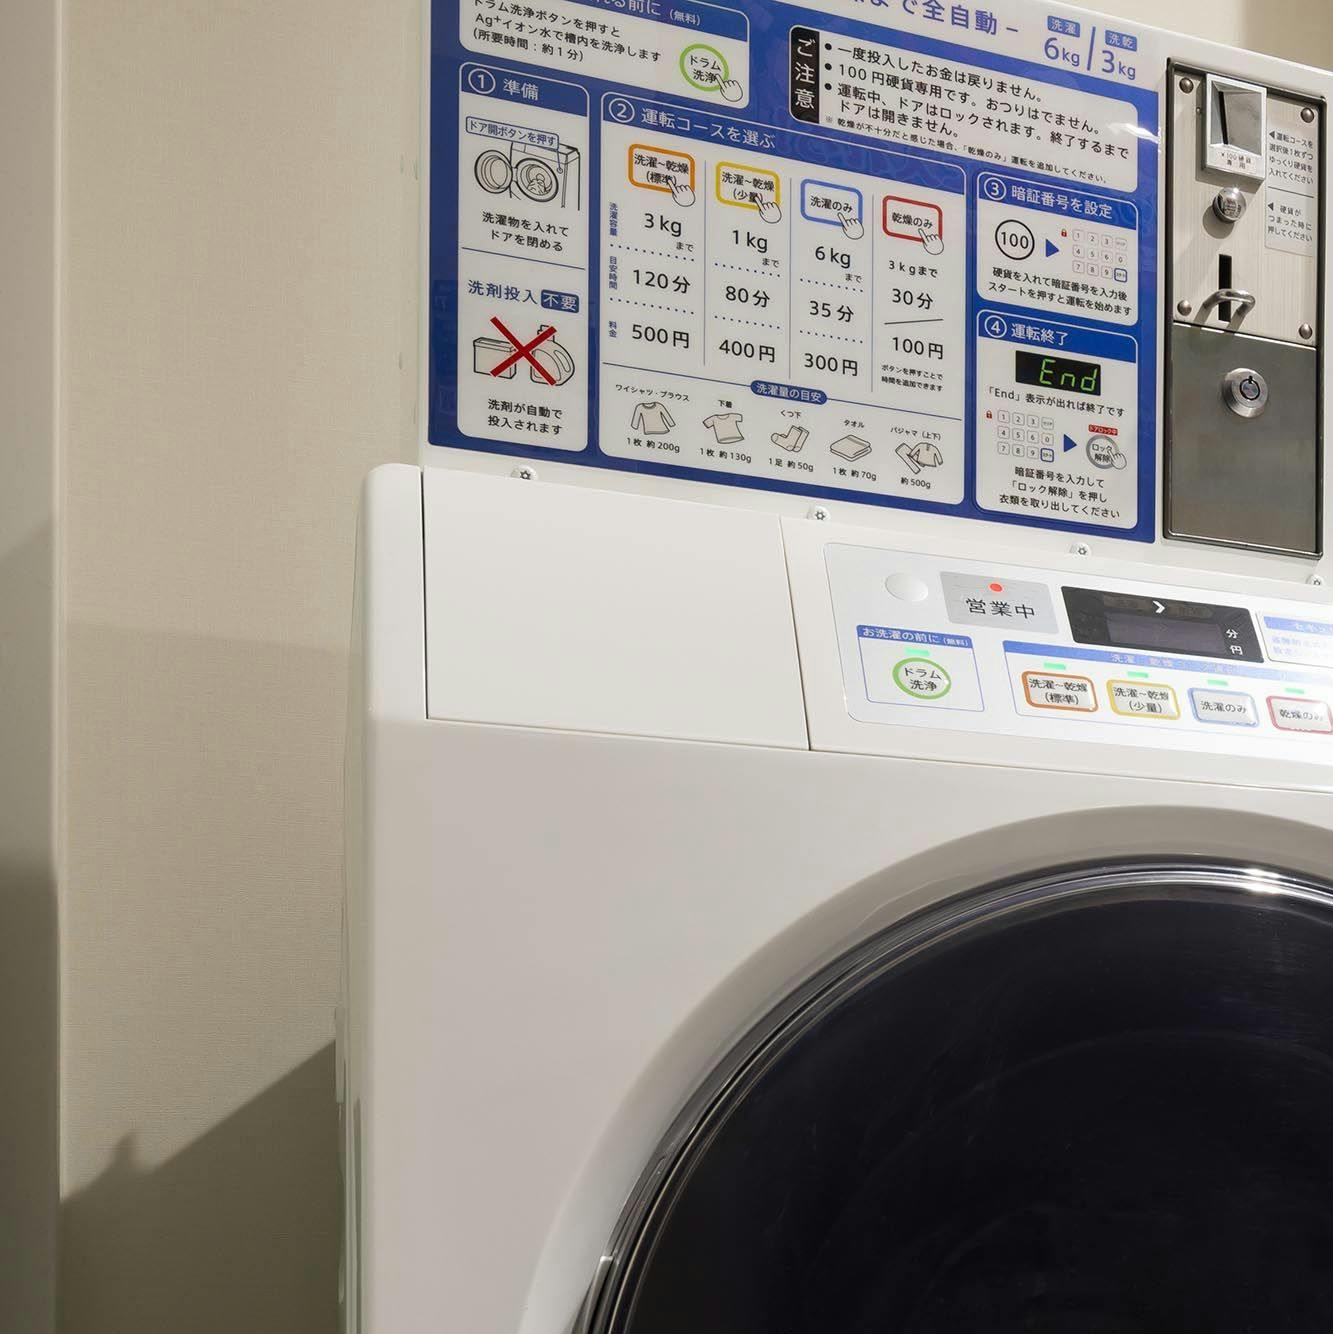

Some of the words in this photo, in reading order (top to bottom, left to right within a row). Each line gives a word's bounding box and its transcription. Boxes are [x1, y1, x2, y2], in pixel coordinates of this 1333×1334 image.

[690, 56, 721, 71] ドラム
[794, 38, 816, 110] ご注意
[837, 45, 1042, 102] 一度投入したお金は戻りません。
[503, 78, 539, 101] 準備
[641, 108, 776, 150] 運転コースを選ぶ
[839, 101, 960, 138] ドアは開きません。
[468, 121, 556, 146] ドア開ボタンを押す
[1269, 168, 1313, 184] 入れてください
[810, 195, 853, 213] 洗濯のみ
[1011, 185, 1112, 220] 暗証番号を設定
[481, 210, 569, 237] 洗濯物を入れて
[892, 212, 933, 230] 乾燥のみ
[491, 229, 563, 252] ドアを閉める
[1000, 231, 1029, 249] 100
[1267, 225, 1312, 242] 押してください
[468, 280, 538, 305] 洗剤投入
[633, 269, 691, 294] 120分
[992, 267, 1128, 301] 硬貨を入れて暗証番号を入力後
[725, 285, 770, 308] 80分
[892, 288, 933, 310] 30分
[988, 281, 1132, 316] スタートを押すと運転を始めます
[809, 300, 854, 323] 35分
[632, 324, 690, 349] 500円
[1011, 323, 1069, 346] 運転終了
[719, 339, 776, 363] 400円
[892, 336, 944, 360] 100円
[804, 352, 858, 377] 300円
[1039, 359, 1098, 392] End
[756, 383, 822, 403] 洗濯量の目安
[487, 398, 563, 420] 洗剤が自動で
[487, 415, 563, 435] 投入されます
[843, 419, 864, 429] タオル
[1014, 466, 1105, 488] 暗証番号を入力して
[999, 494, 1120, 519] 衣類を取り出してください
[965, 597, 1035, 619] 営業中
[904, 667, 943, 681] ドラム
[910, 679, 937, 691] 洗浄
[1200, 700, 1247, 714] 洗濯のみ
